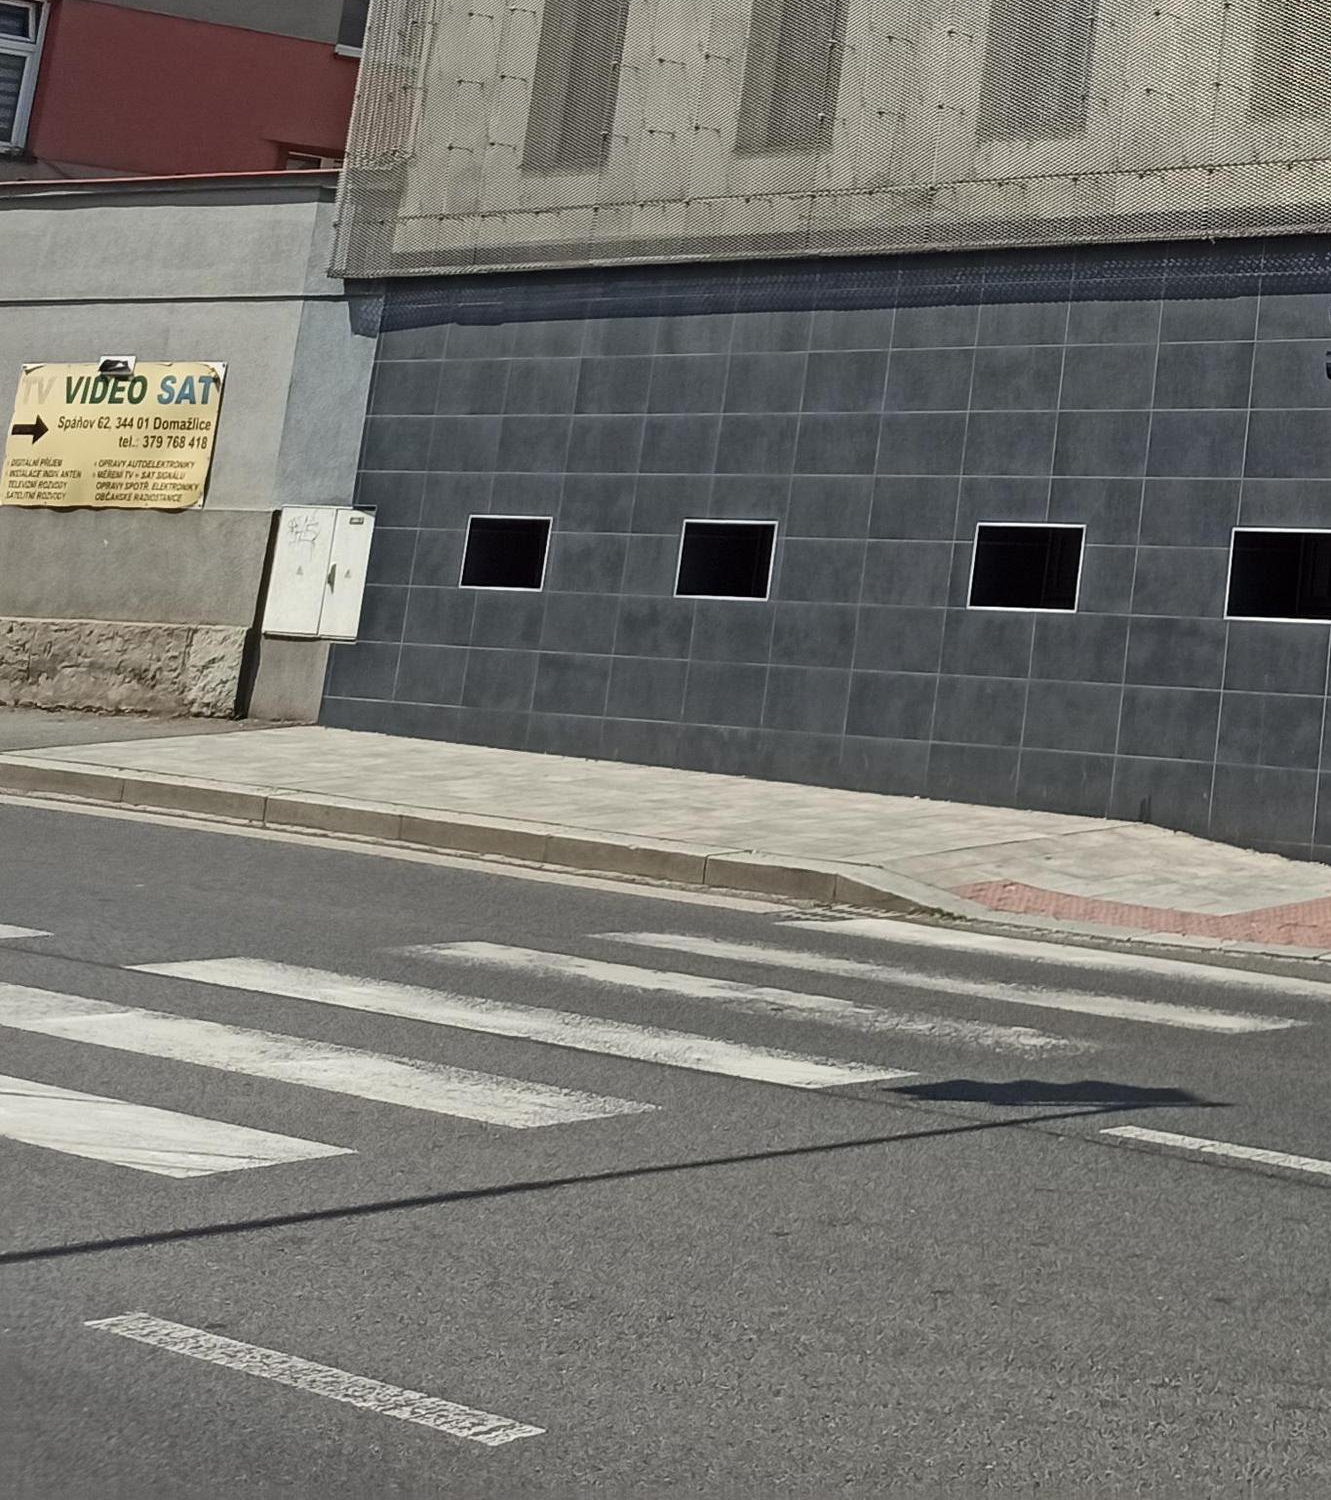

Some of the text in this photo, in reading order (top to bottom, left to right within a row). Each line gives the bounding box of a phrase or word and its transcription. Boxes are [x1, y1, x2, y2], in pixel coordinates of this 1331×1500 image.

[22, 374, 215, 405] TV VIDEO SAT
[115, 416, 136, 430] 344
[137, 416, 150, 431] 01
[153, 416, 211, 432] Domažlice
[142, 436, 163, 449] 379
[166, 436, 186, 449] 768
[188, 436, 208, 450] 418
